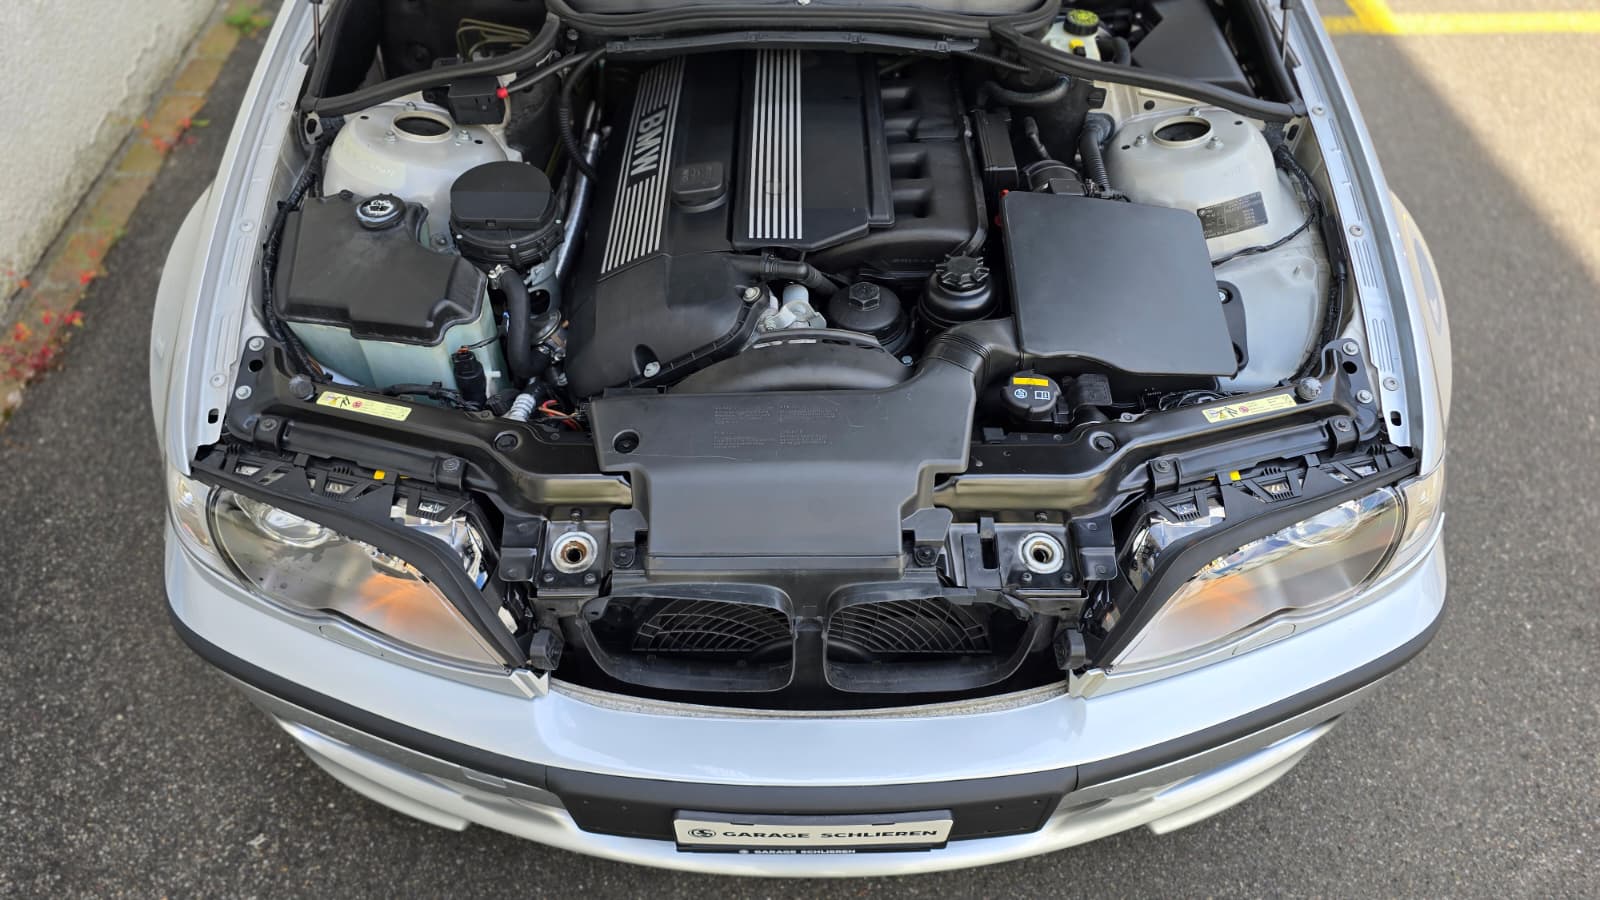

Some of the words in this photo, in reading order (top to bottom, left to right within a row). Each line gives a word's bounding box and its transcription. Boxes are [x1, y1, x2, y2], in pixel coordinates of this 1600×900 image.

[630, 109, 666, 176] BMW
[722, 831, 810, 839] GARAGE
[820, 830, 938, 838] SCHLIEREN
